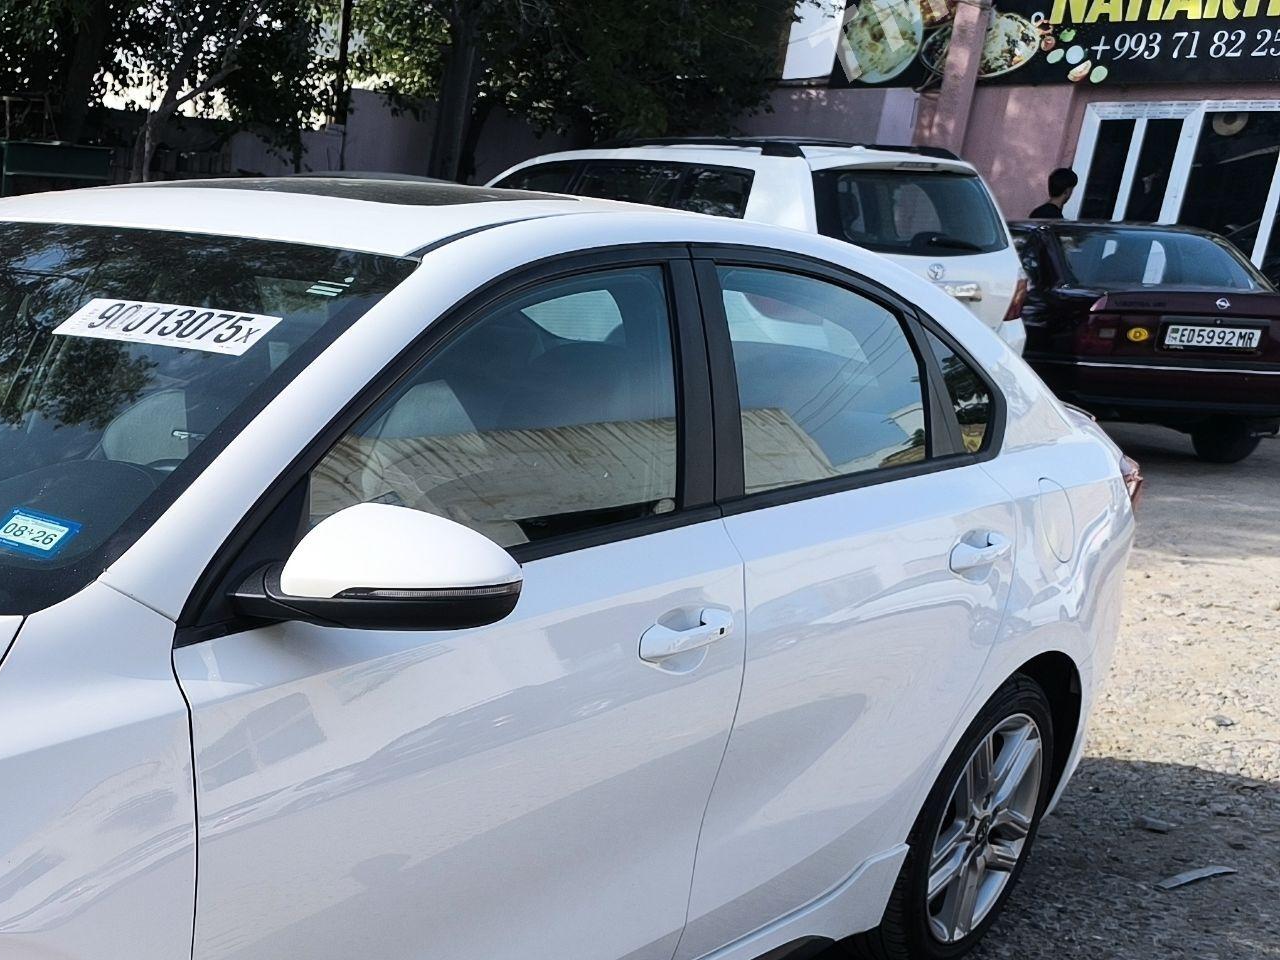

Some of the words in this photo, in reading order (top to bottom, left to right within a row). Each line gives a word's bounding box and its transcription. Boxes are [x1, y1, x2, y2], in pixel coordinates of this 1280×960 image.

[1090, 32, 1162, 60] +993
[1172, 31, 1200, 59] 71
[1209, 29, 1246, 58] 82
